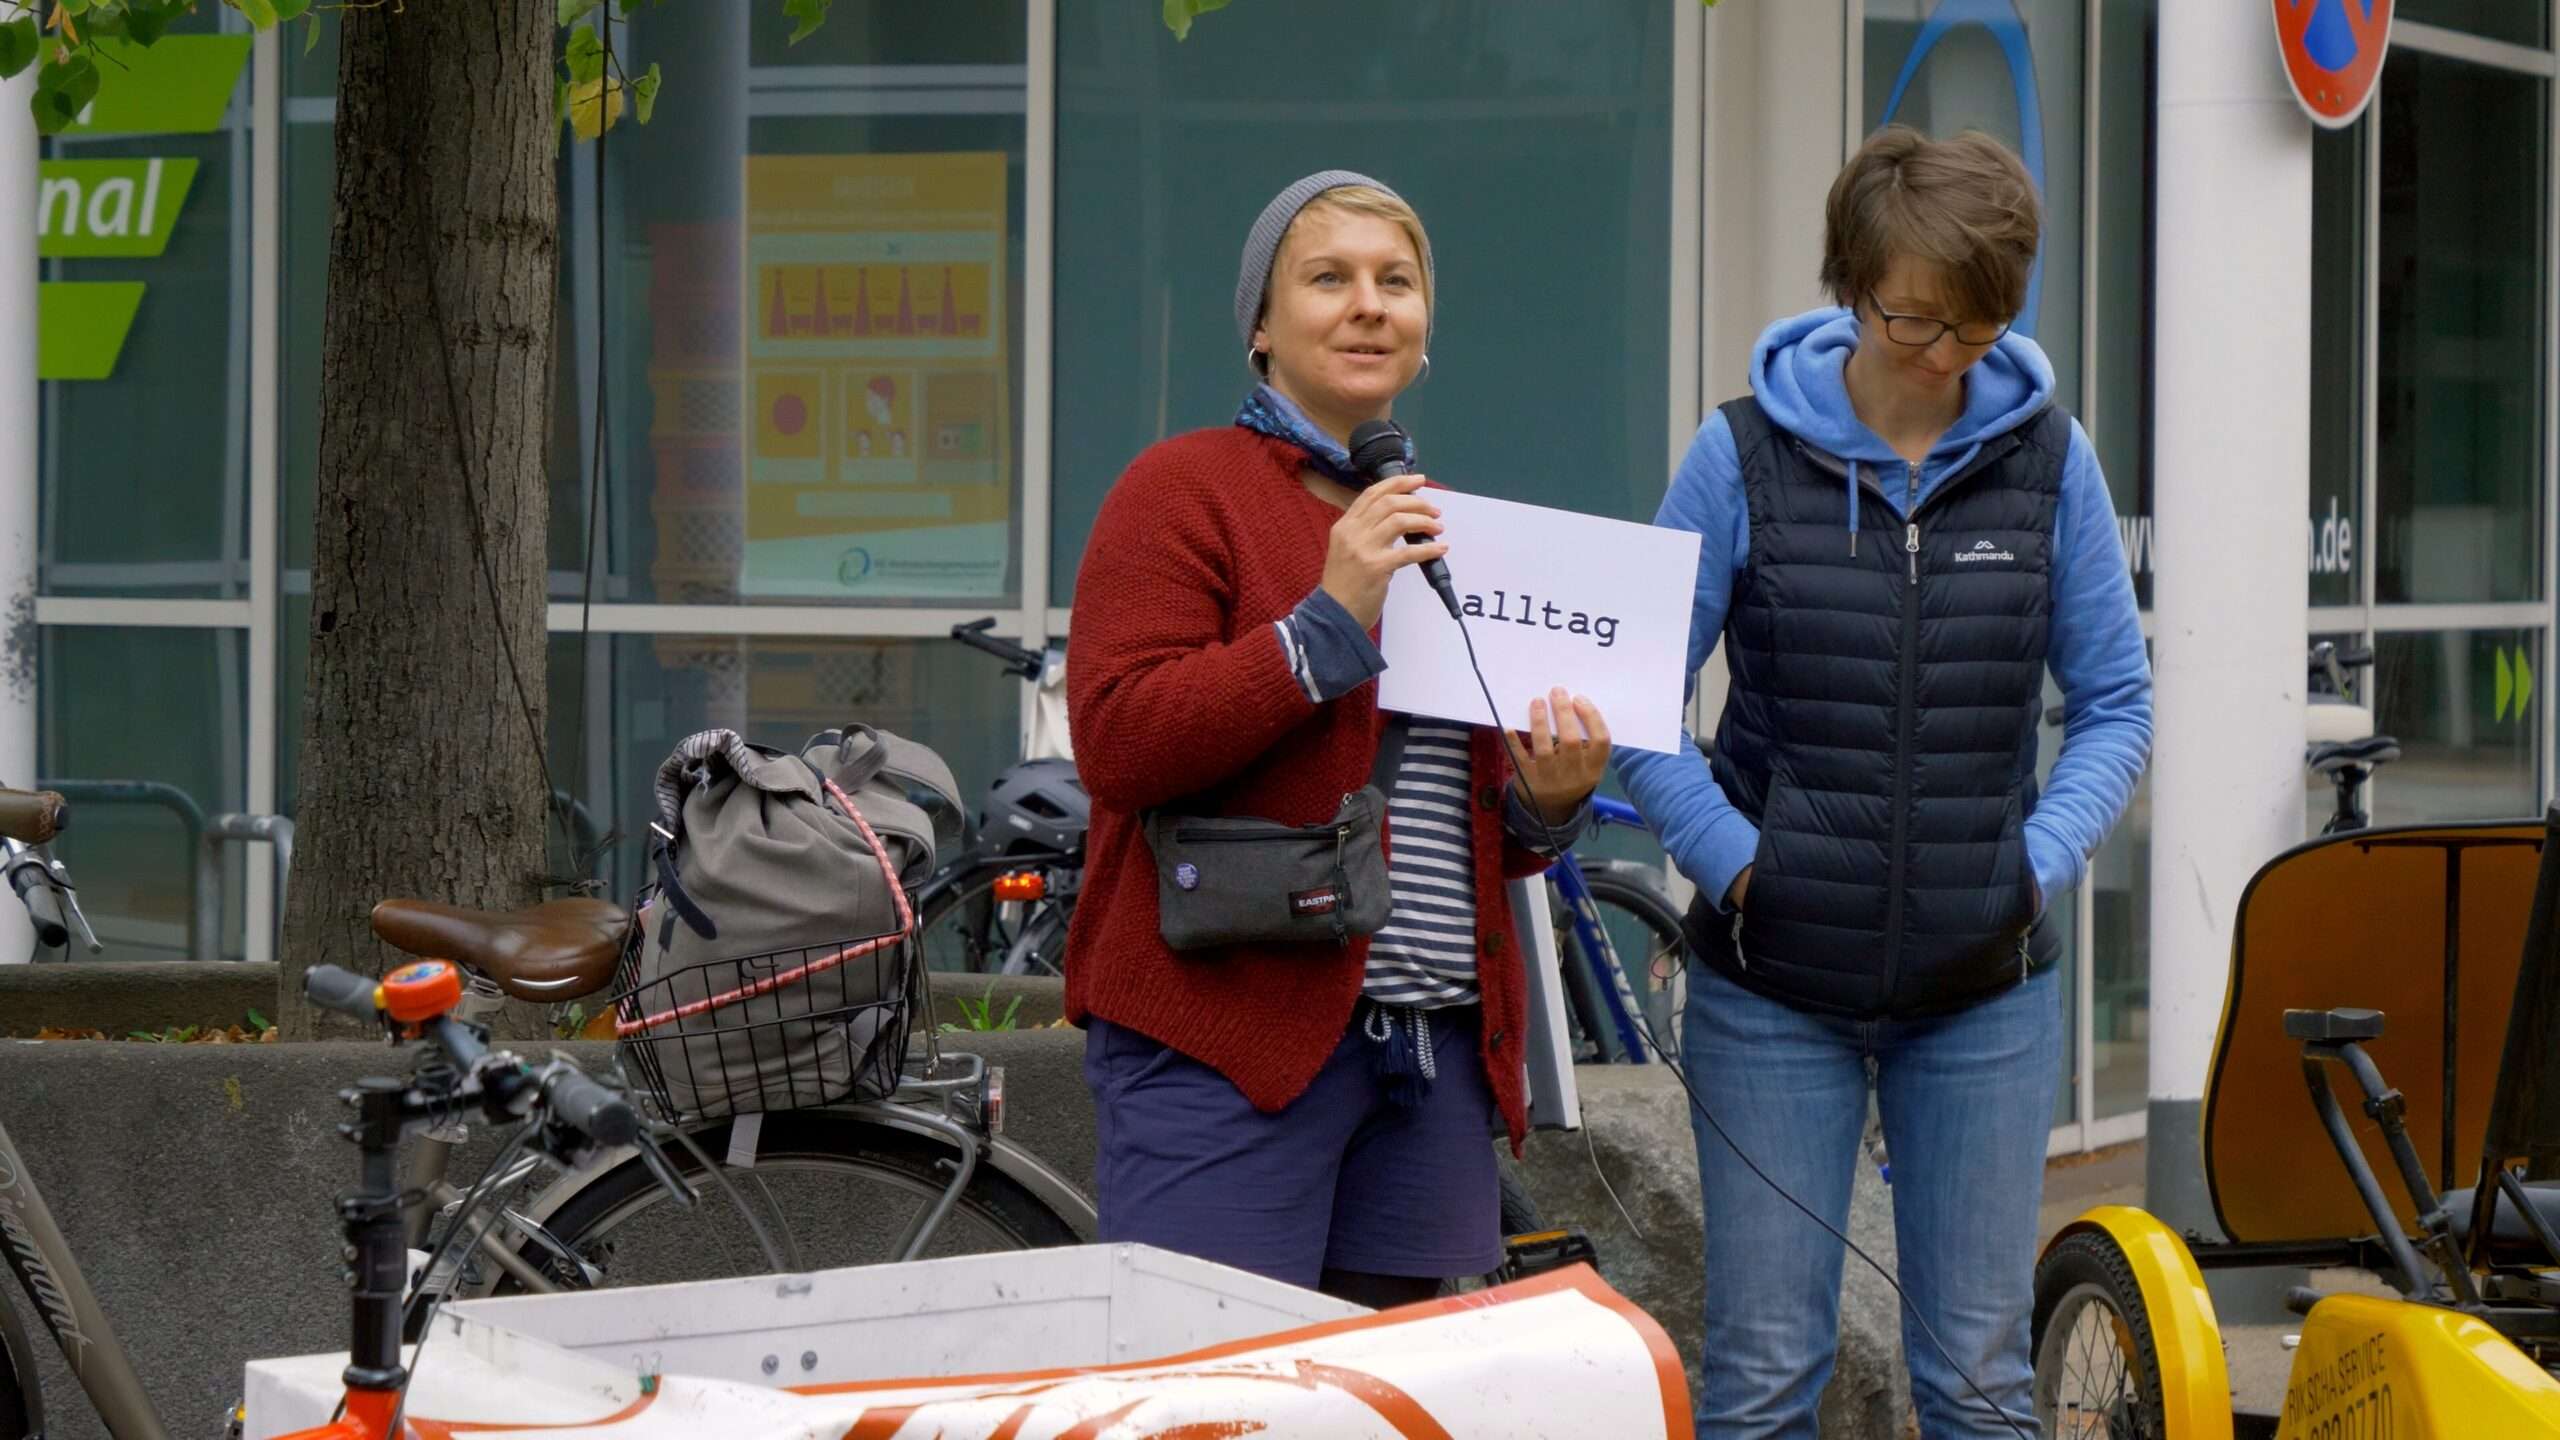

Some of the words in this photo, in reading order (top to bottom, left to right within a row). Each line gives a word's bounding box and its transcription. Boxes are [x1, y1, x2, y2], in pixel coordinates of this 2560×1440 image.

[1954, 550, 2014, 562] Kathmandu
[1462, 590, 1620, 647] alltag
[1298, 894, 1336, 907] EASTPA
[2338, 1331, 2385, 1396] SERVICE
